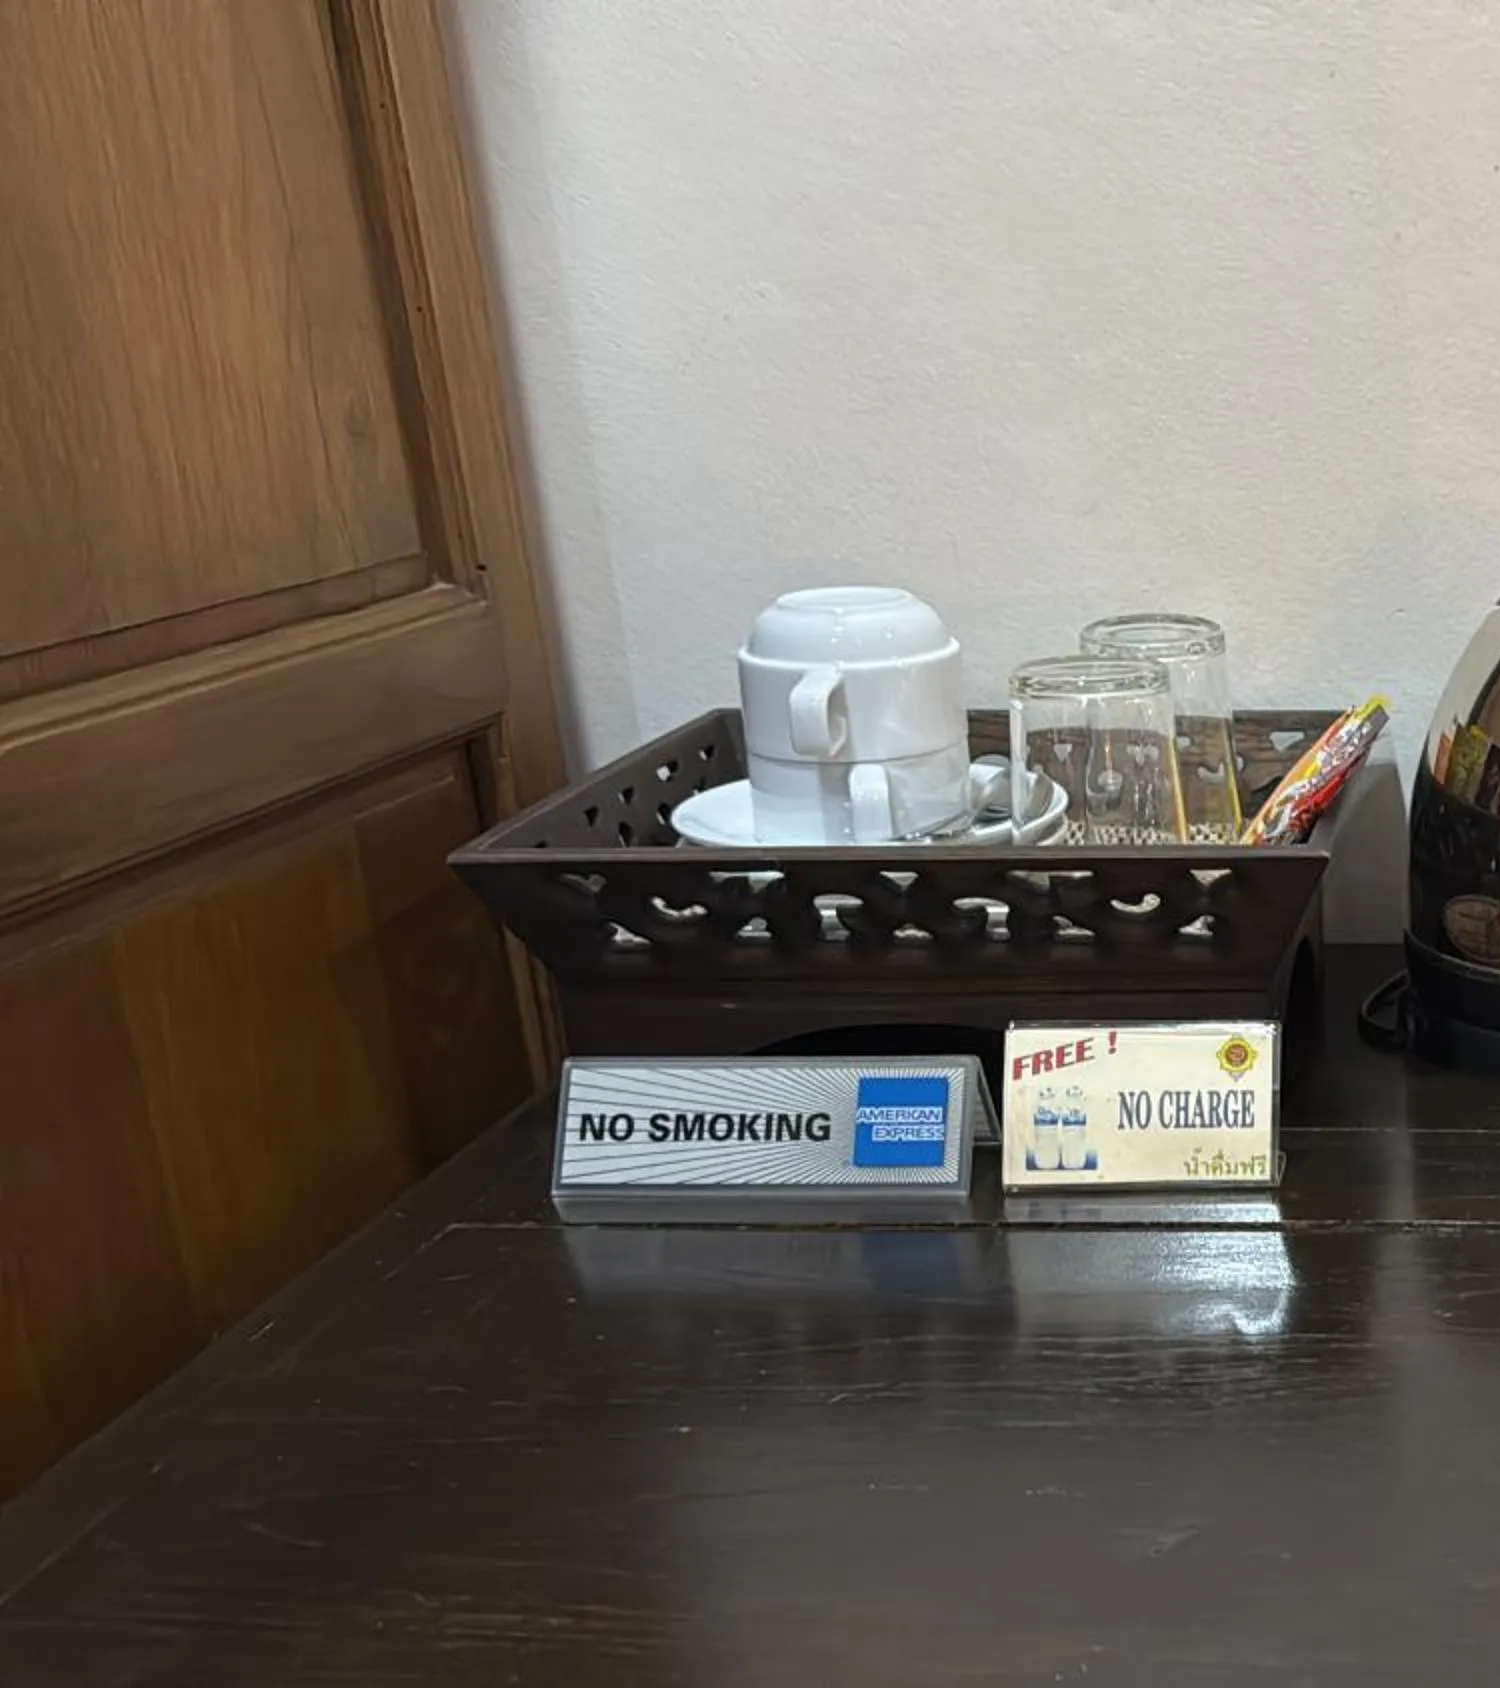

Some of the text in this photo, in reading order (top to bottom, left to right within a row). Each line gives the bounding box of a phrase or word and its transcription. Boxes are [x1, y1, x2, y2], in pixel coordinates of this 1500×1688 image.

[1012, 1037, 1095, 1081] FREE
[856, 1106, 942, 1123] AMERICAN
[1118, 1090, 1255, 1130] NO CHARGE
[579, 1112, 831, 1142] NO SMOKING
[872, 1126, 945, 1141] EXPRESS
